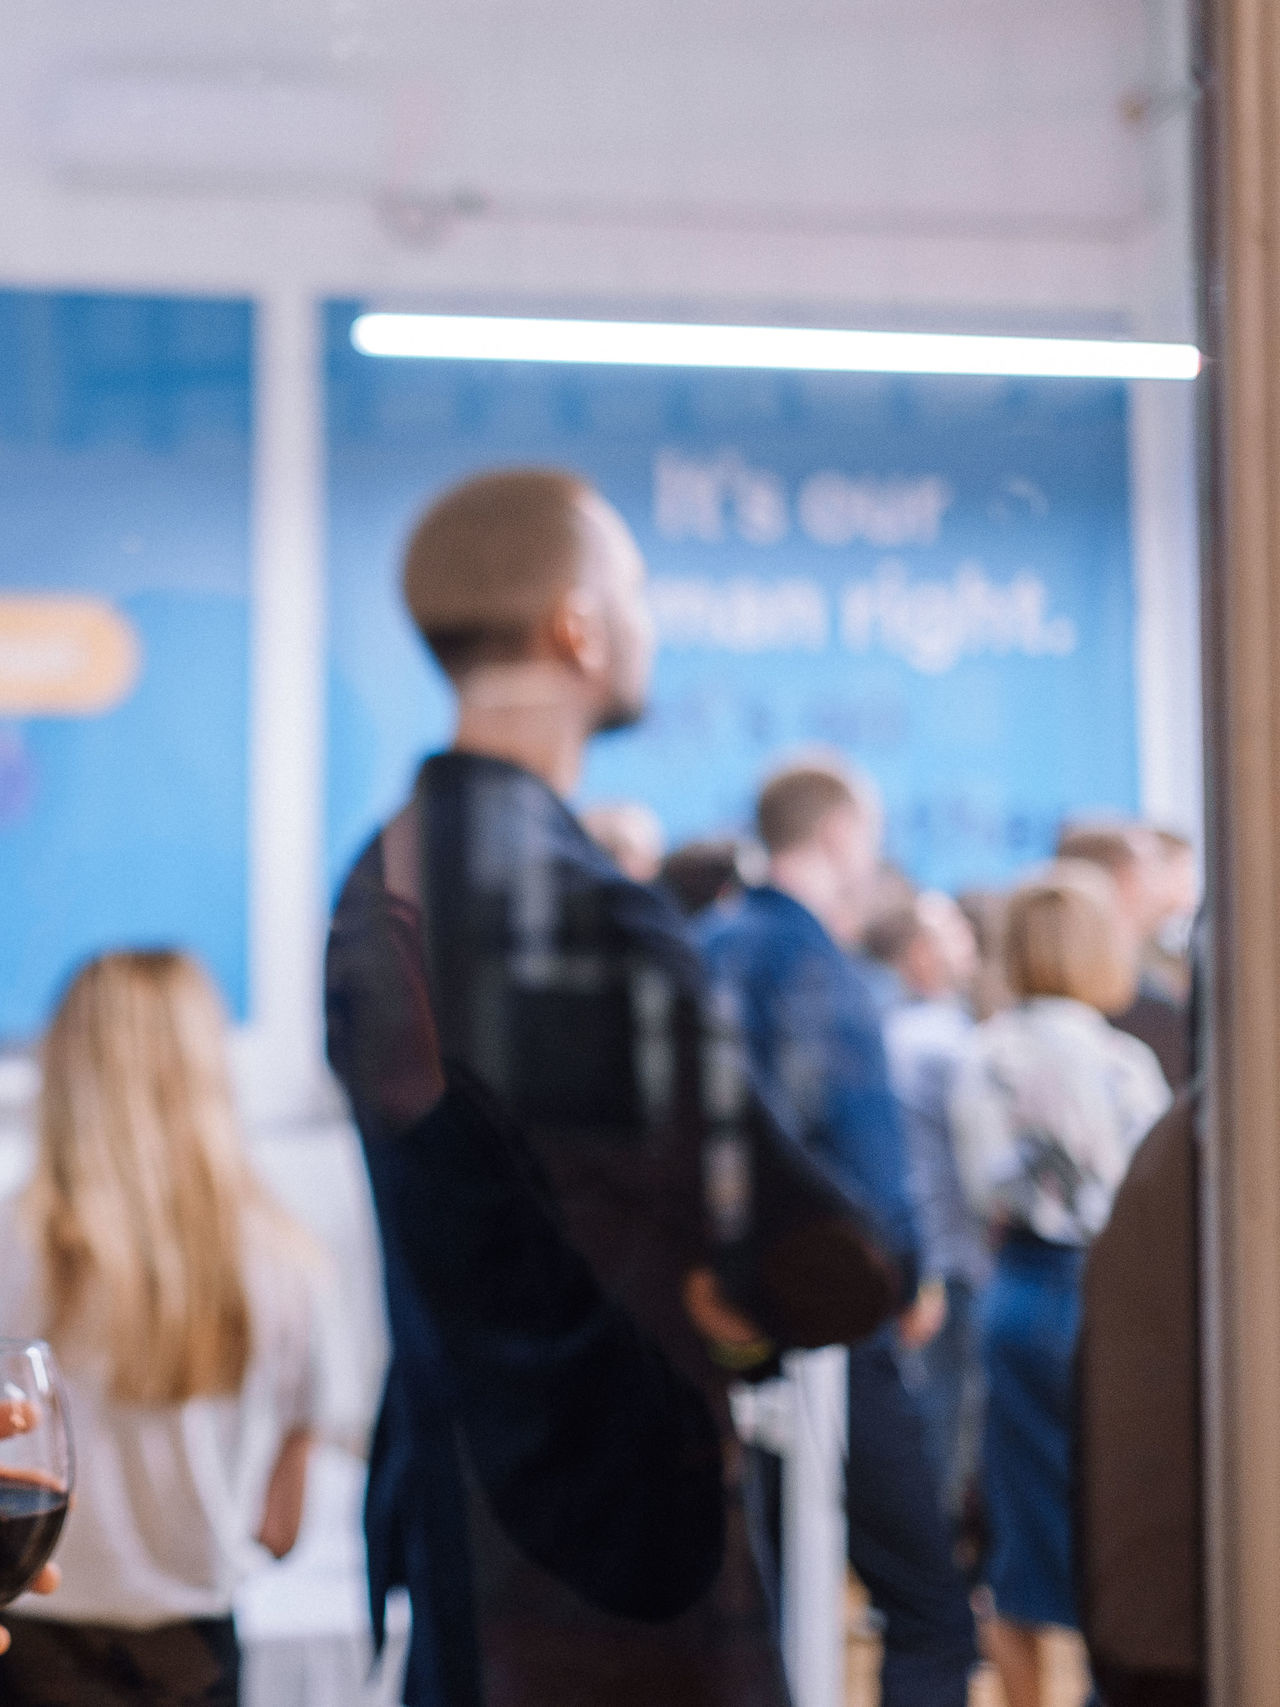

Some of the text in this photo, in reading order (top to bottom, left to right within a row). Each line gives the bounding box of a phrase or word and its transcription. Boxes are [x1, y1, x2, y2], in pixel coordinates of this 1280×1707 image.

[654, 447, 951, 547] It's our
[841, 558, 1079, 676] right.
